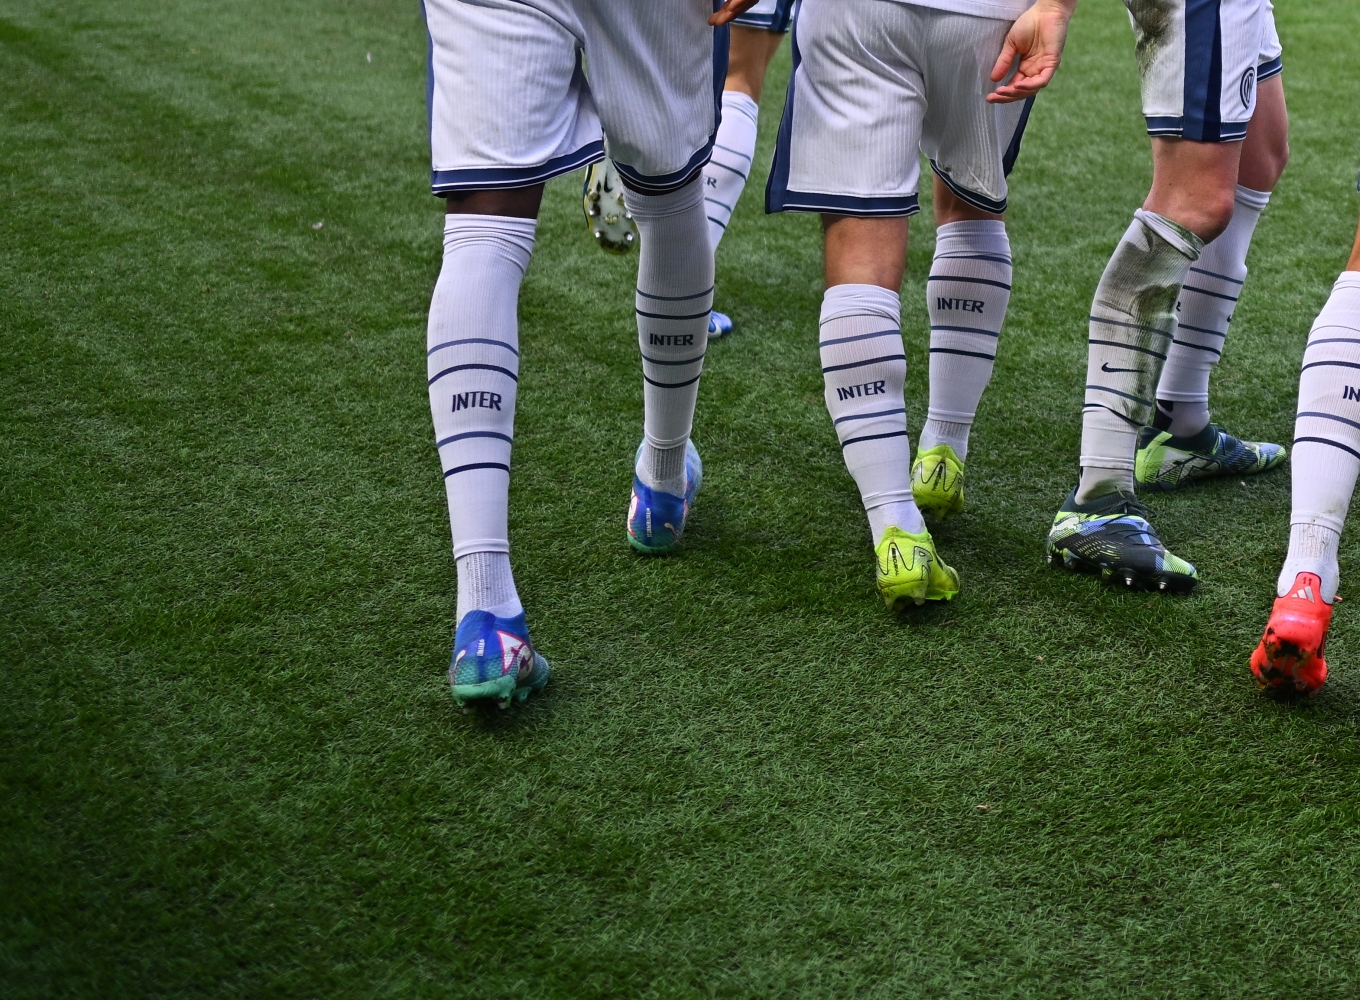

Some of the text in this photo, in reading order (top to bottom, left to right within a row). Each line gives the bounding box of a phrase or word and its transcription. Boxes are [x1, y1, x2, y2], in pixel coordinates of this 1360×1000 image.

[936, 295, 985, 315] INTER
[649, 333, 694, 348] INTER
[837, 379, 886, 402] INTER
[451, 390, 502, 413] INTER
